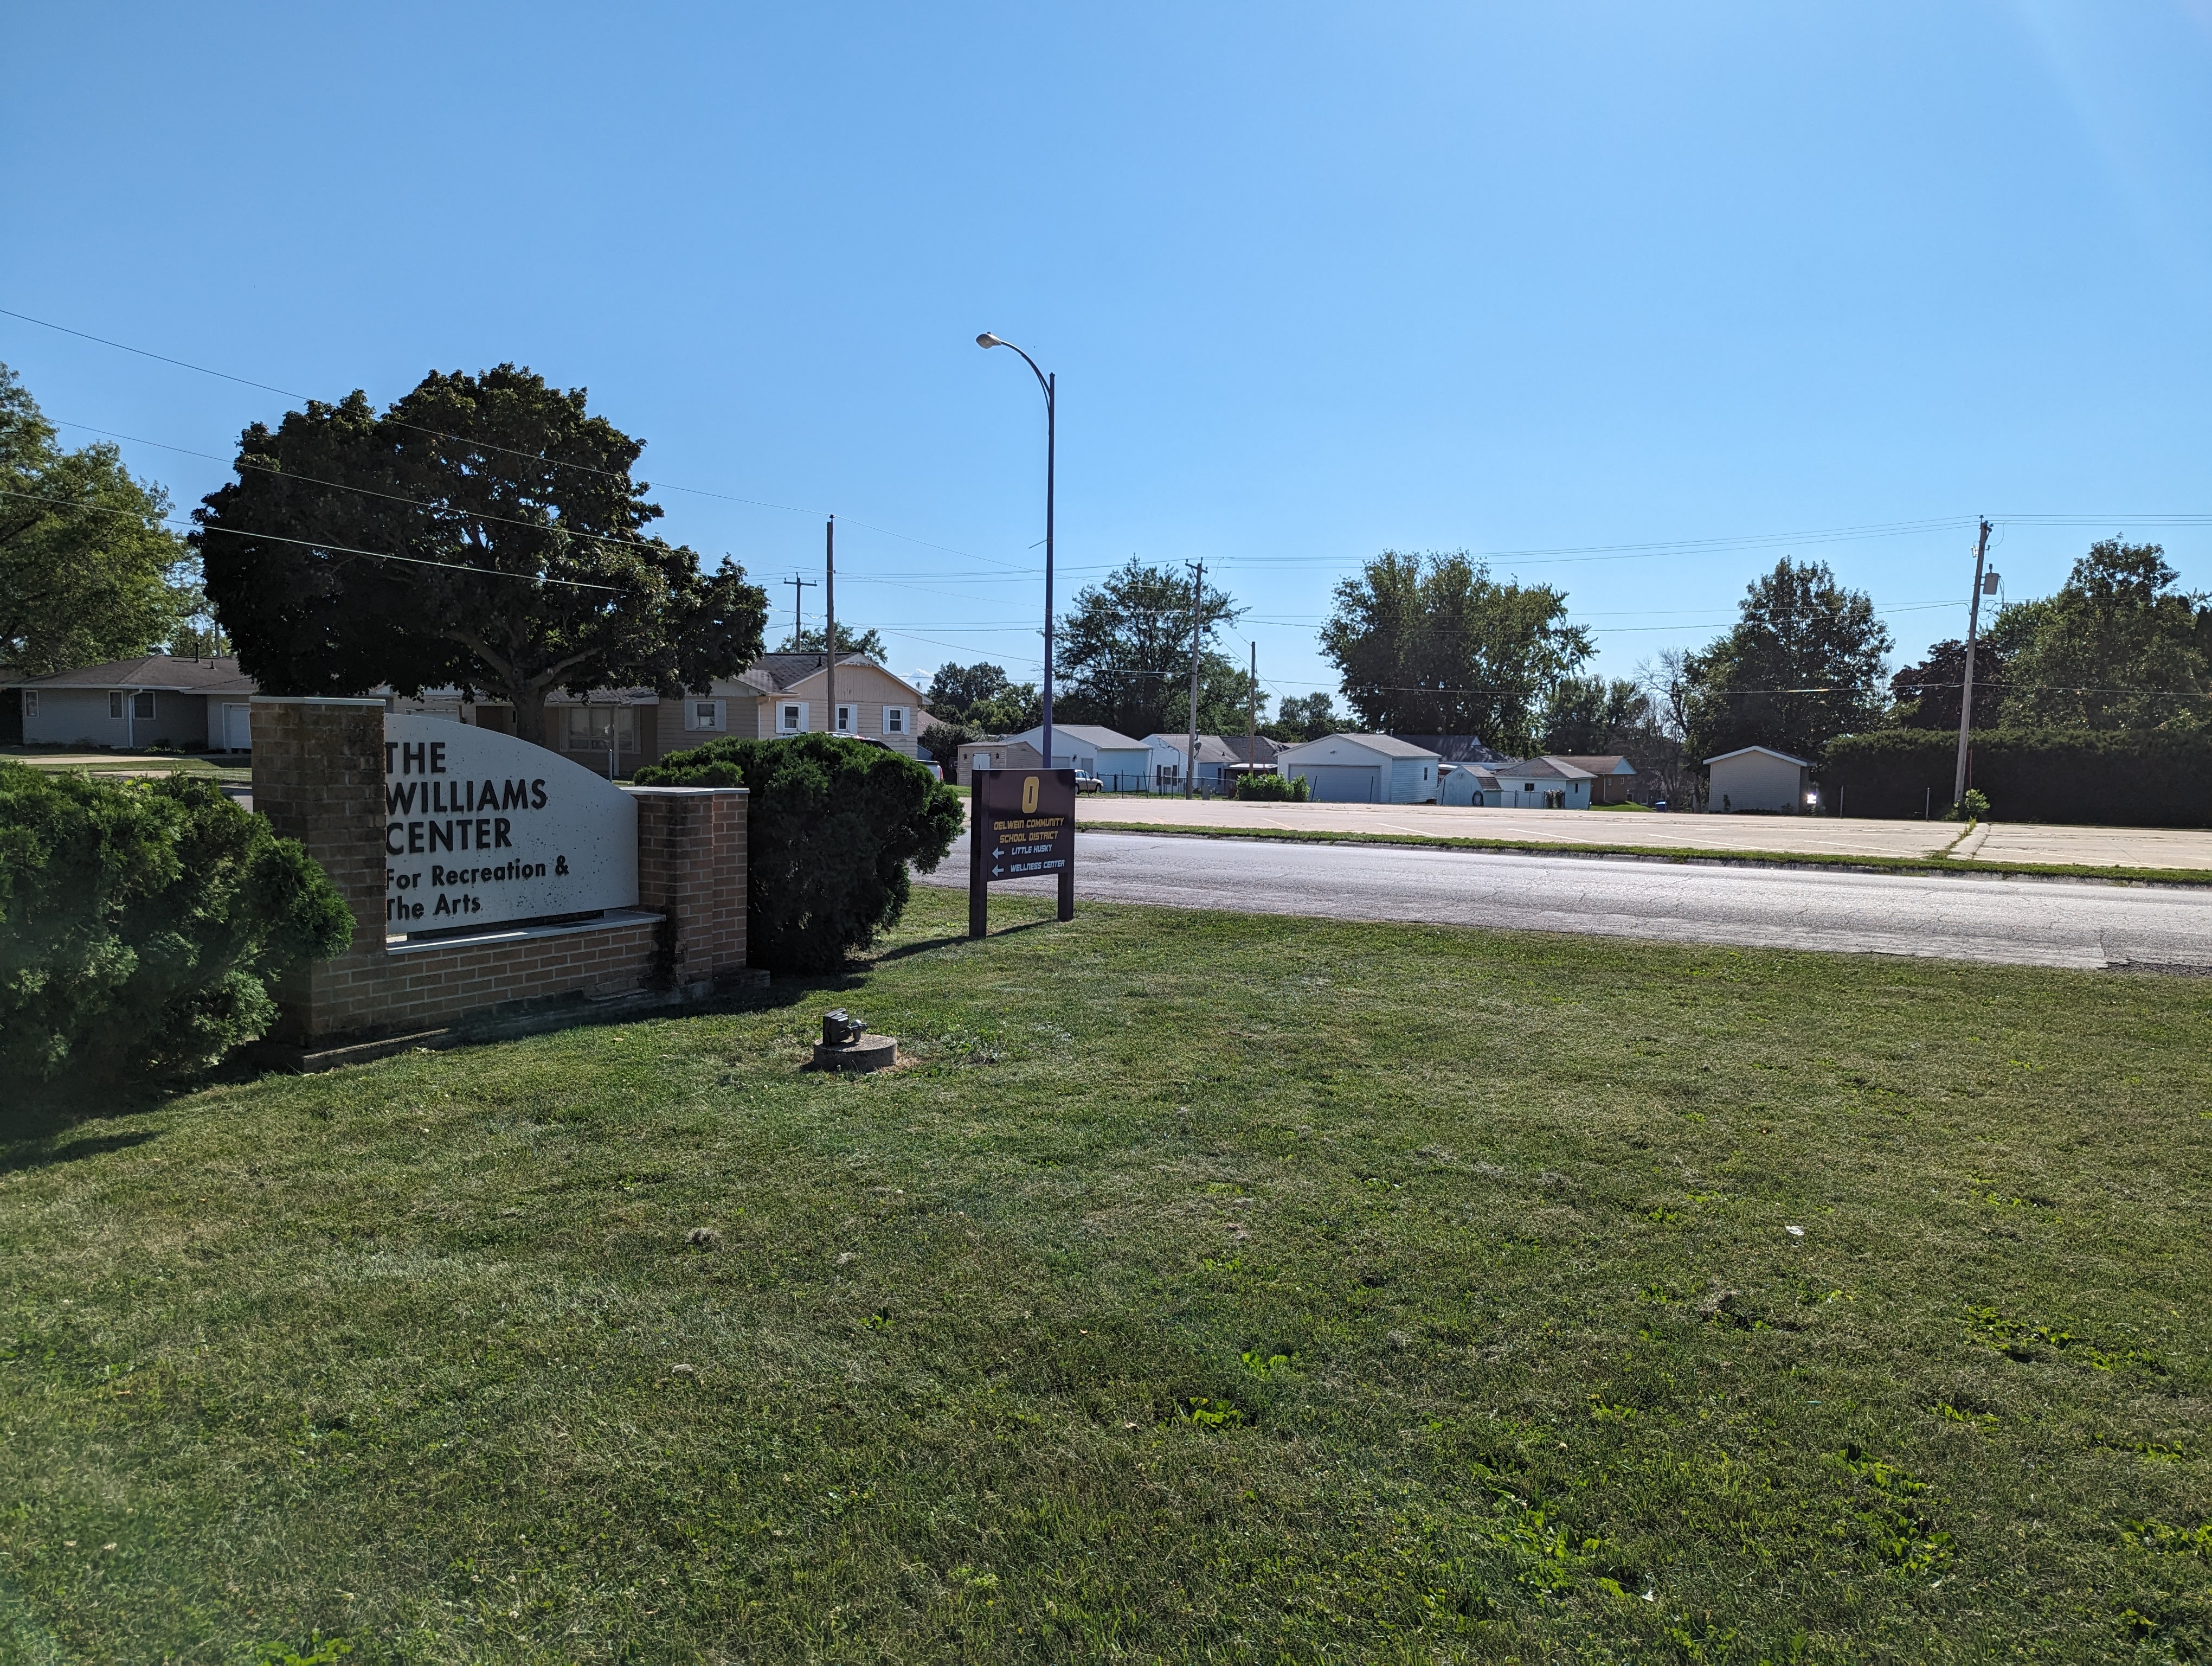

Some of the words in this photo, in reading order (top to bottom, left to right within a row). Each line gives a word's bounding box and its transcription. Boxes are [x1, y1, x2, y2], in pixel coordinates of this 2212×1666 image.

[386, 742, 446, 773] THE
[386, 779, 547, 815] WILLIAMS
[386, 818, 512, 855] CENTER
[994, 819, 1024, 831] OELWEIN
[1026, 817, 1064, 829] COMMUNITY
[999, 833, 1026, 844] SCHOOL
[1028, 830, 1059, 841] DISTRICT
[1011, 846, 1032, 855] LITTLE
[1033, 844, 1052, 853] HUSKY
[387, 868, 421, 889] For
[432, 858, 546, 886] Recreation
[555, 855, 569, 875] &
[1011, 861, 1041, 872] WELLNESS
[1043, 860, 1065, 869] CENTER
[387, 895, 425, 920] The
[434, 893, 481, 915] Arts
